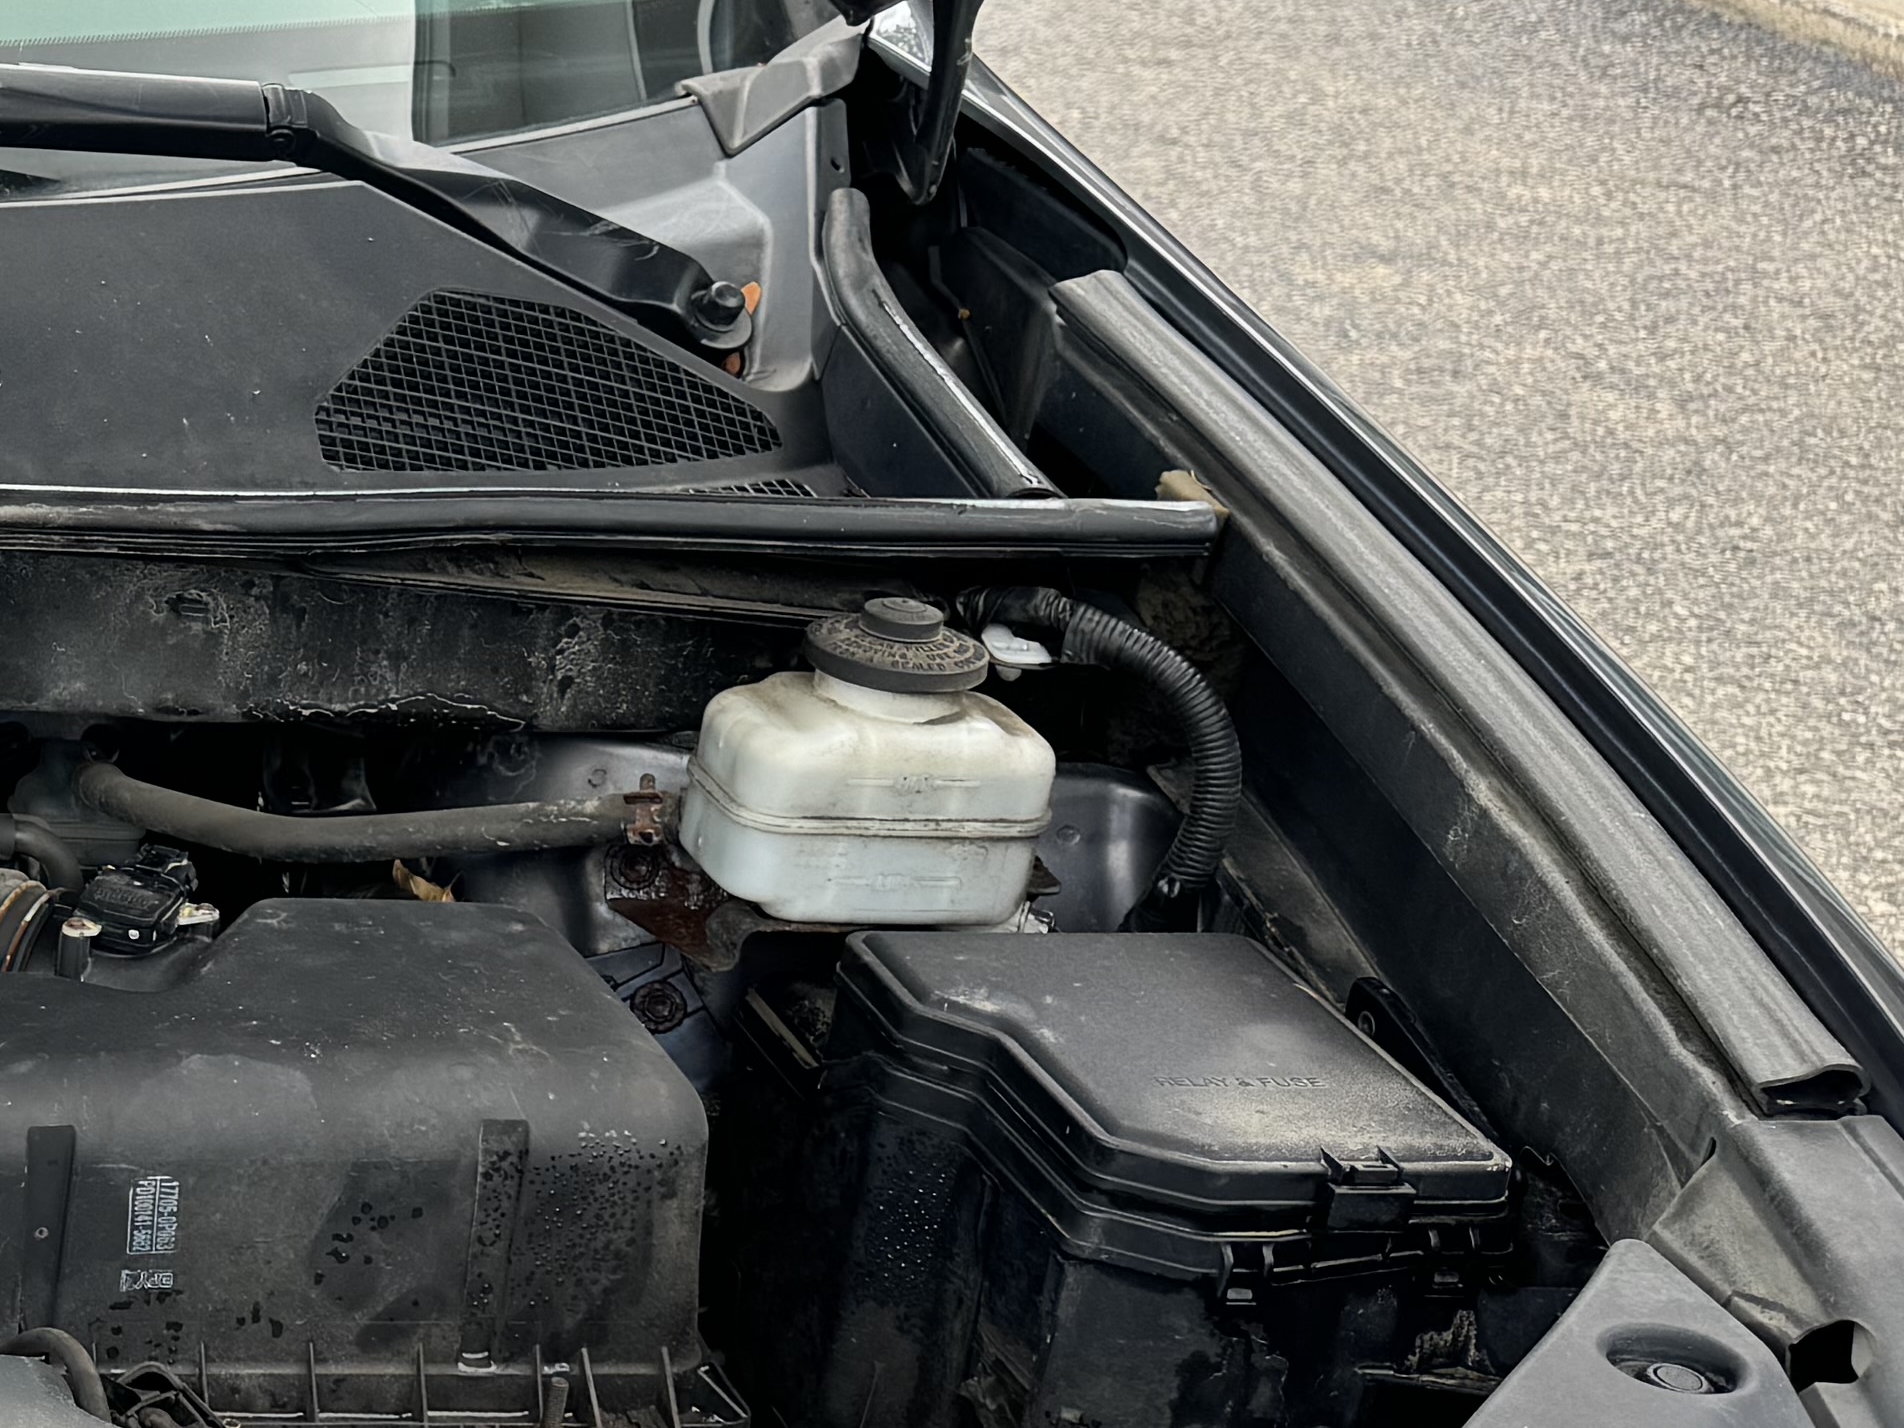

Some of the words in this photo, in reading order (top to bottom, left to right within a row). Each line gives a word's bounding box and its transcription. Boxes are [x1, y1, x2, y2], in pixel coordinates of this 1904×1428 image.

[1153, 1076, 1229, 1088] RELAY
[1235, 1076, 1255, 1088] &
[1256, 1076, 1328, 1088] FUSE
